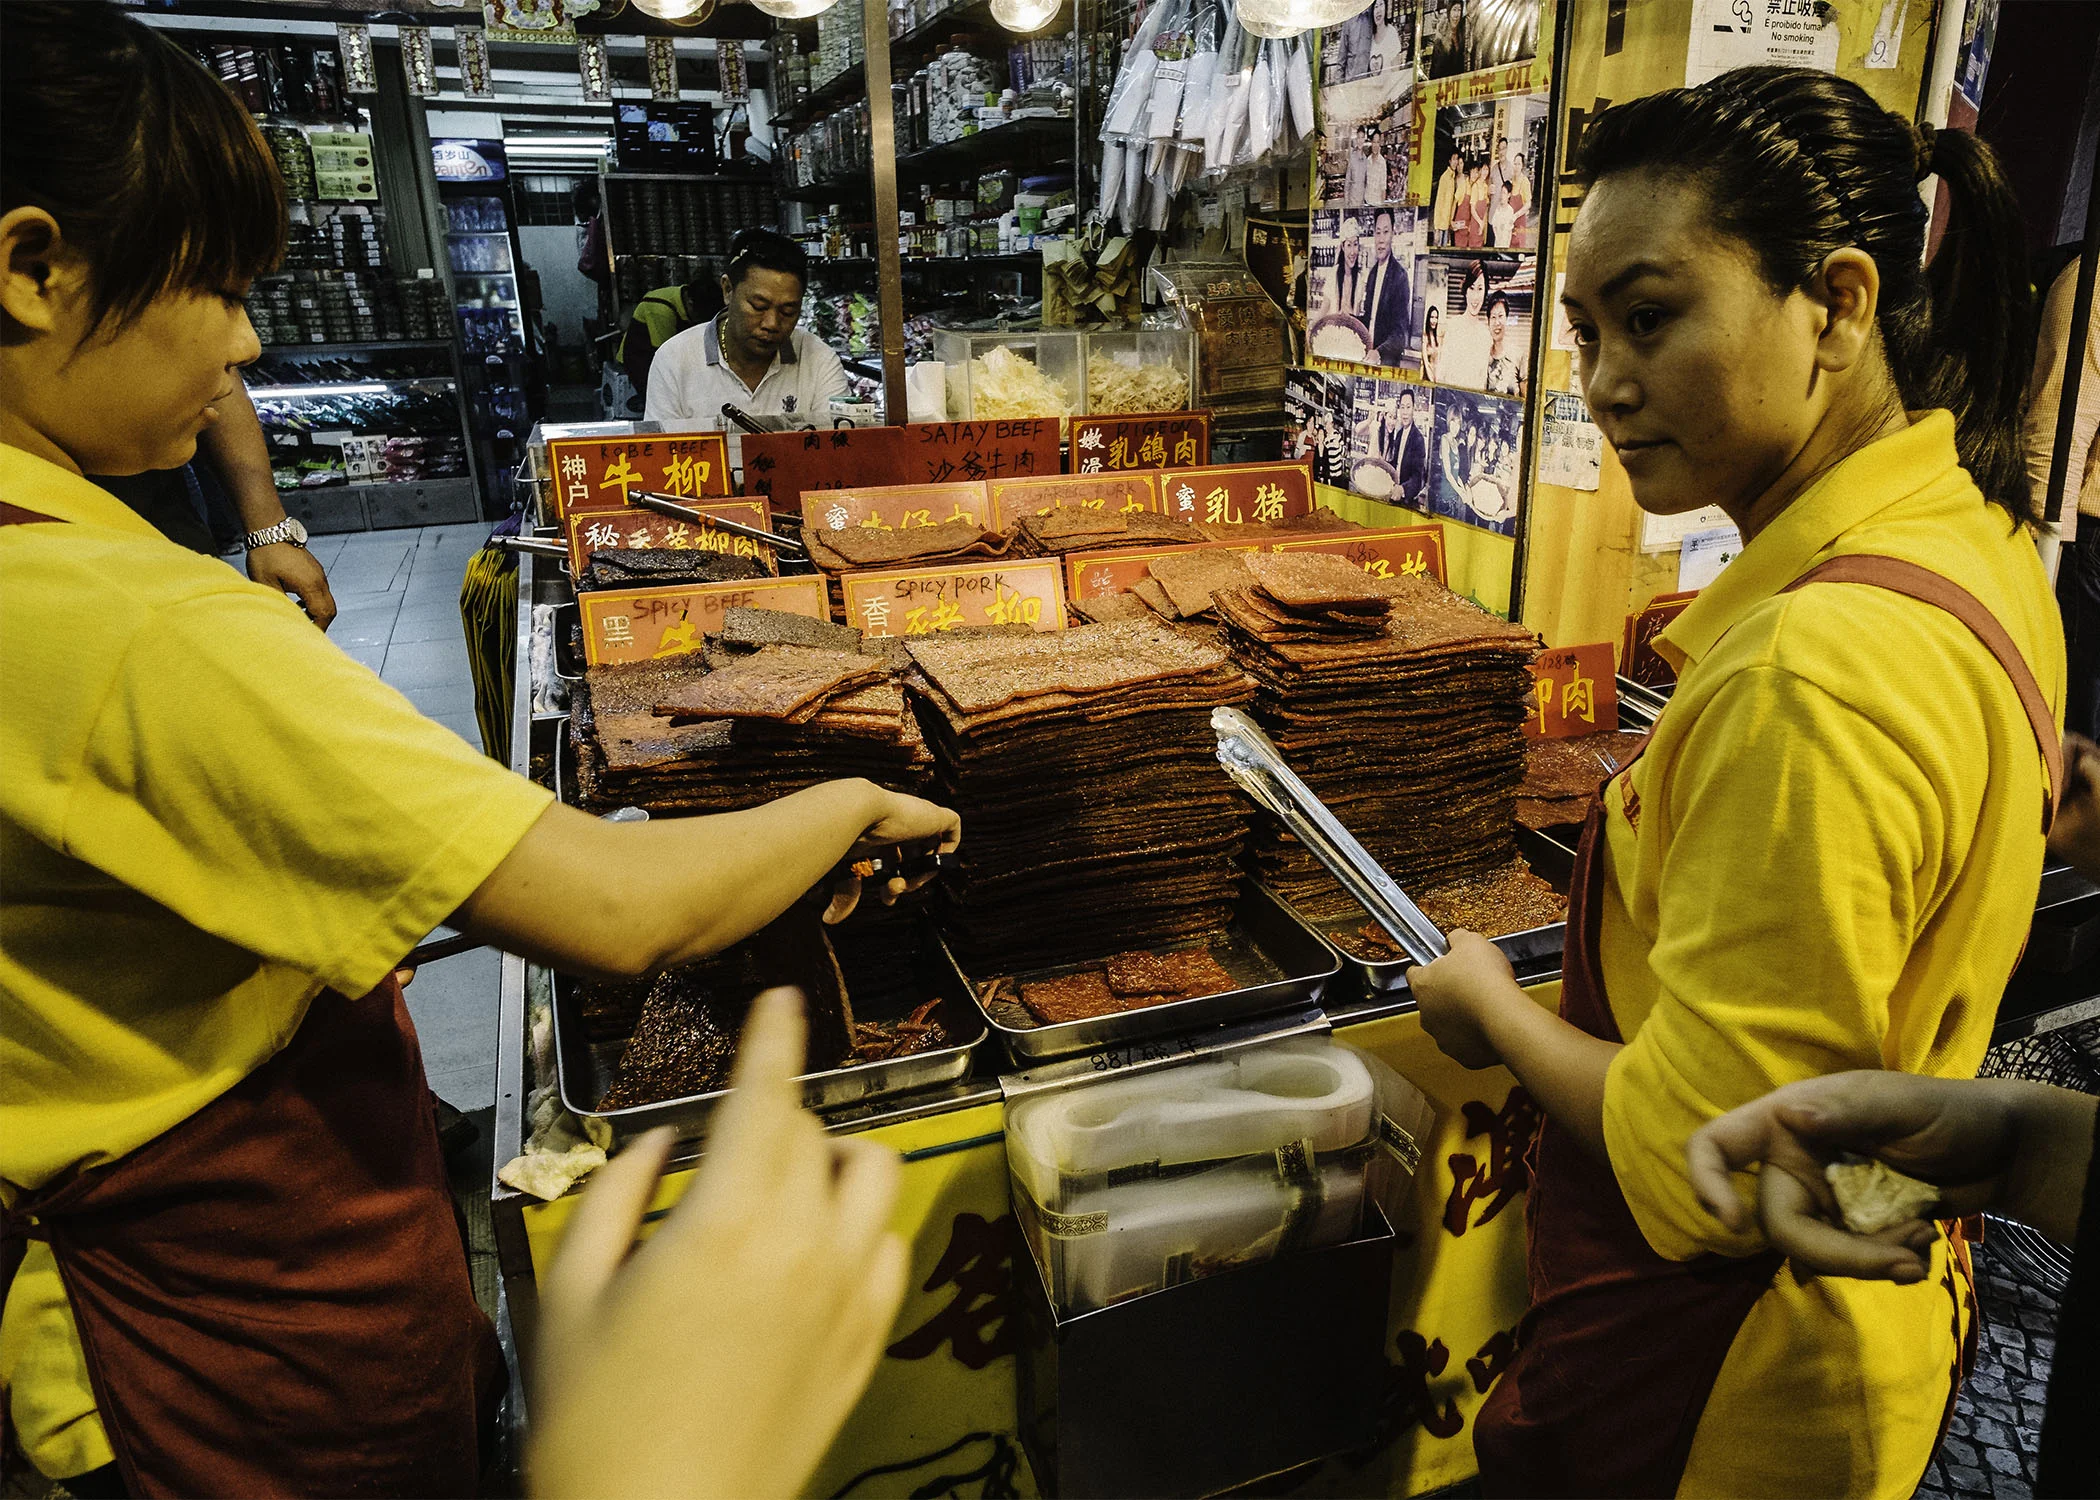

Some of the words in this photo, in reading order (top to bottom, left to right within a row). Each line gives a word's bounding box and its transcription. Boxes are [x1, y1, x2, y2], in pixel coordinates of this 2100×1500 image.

[1771, 20, 1802, 30] proibido
[1771, 31, 1782, 41] No
[1783, 34, 1815, 45] smoking
[920, 420, 989, 447] SATAY
[996, 419, 1044, 439] BEEF
[599, 450, 711, 506] 牛柳
[894, 578, 948, 601] SPICY
[955, 573, 1010, 599] PORK
[632, 597, 691, 624] SPICY
